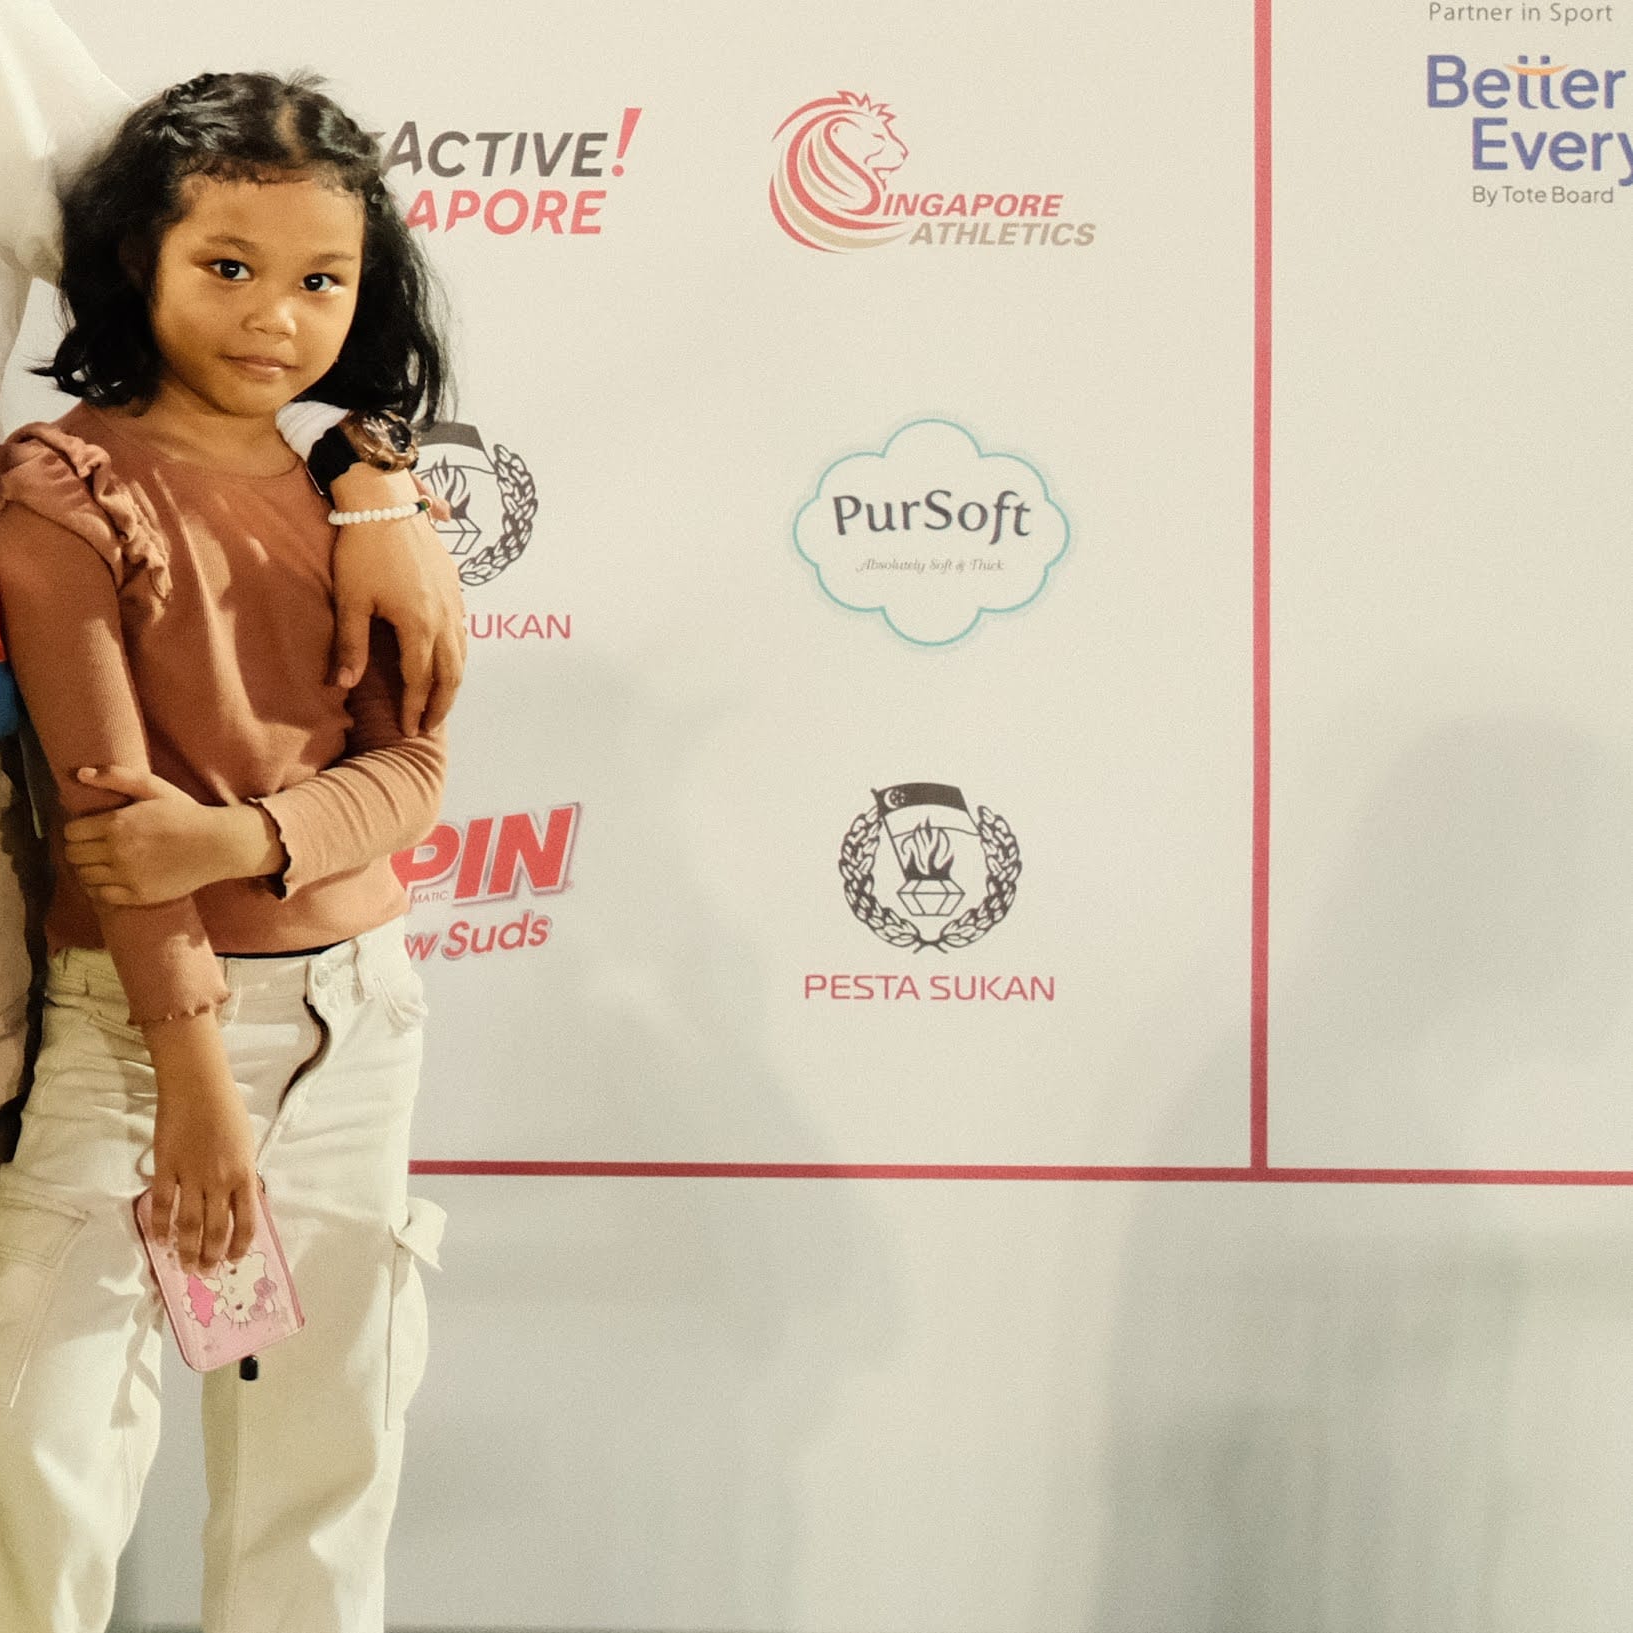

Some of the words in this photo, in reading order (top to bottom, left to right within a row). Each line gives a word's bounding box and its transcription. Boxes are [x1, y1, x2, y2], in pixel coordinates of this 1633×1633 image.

[1429, 2, 1512, 21] Partner
[1522, 3, 1540, 21] in
[1550, 3, 1613, 26] Sport
[1473, 186, 1498, 207] By
[1503, 186, 1547, 203] Tote
[1552, 186, 1613, 203] Board
[405, 189, 607, 235] APORE
[910, 223, 1095, 248] ATHLETICS
[833, 489, 1031, 546] PurSoft
[470, 614, 572, 639] UKAN
[390, 805, 573, 900] PIN
[443, 912, 549, 959] Suds
[804, 975, 921, 1001] PESTA
[929, 975, 1055, 1002] SUKAN
